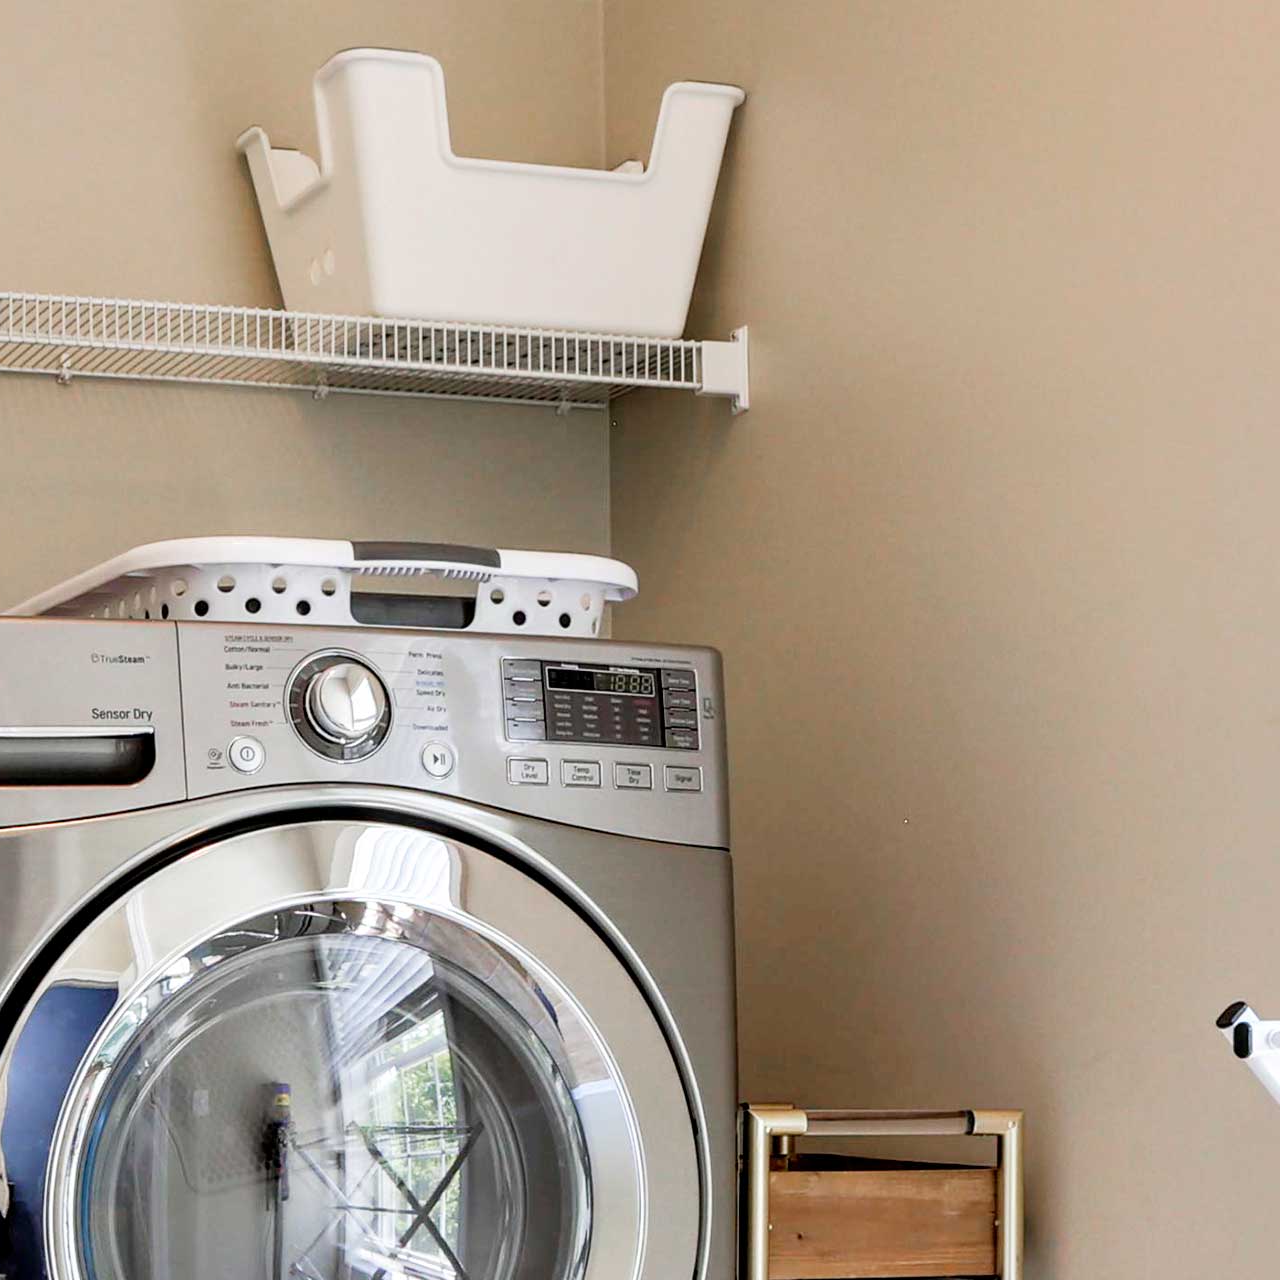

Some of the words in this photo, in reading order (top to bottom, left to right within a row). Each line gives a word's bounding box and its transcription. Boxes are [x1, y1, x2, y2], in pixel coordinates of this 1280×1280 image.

[223, 645, 270, 653] Cotton/Normal
[225, 663, 263, 671] Bulky/Large
[91, 707, 131, 720] Sensor
[133, 707, 153, 722] Dry
[523, 763, 535, 772] Dry
[629, 776, 639, 784] Dry
